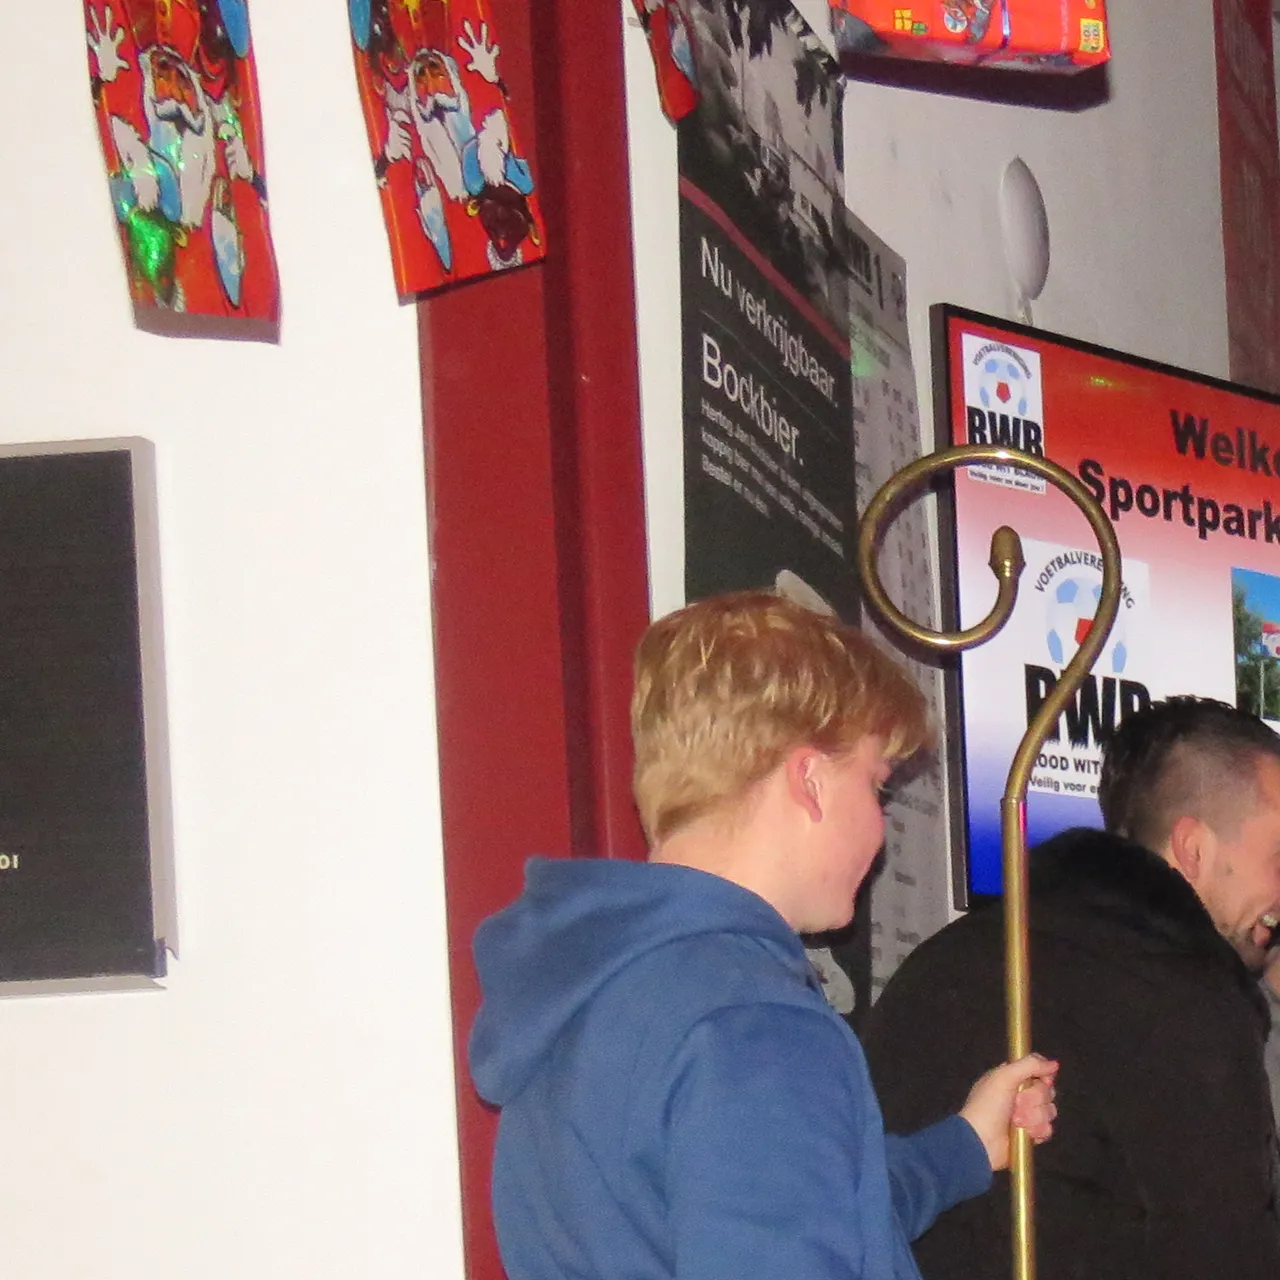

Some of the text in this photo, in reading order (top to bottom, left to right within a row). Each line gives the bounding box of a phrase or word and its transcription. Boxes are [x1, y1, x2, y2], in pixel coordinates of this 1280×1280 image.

[702, 236, 733, 298] Nu
[736, 279, 838, 408] verkrijgbaar.
[702, 333, 803, 467] Bockbier.
[1037, 753, 1069, 771] OOD
